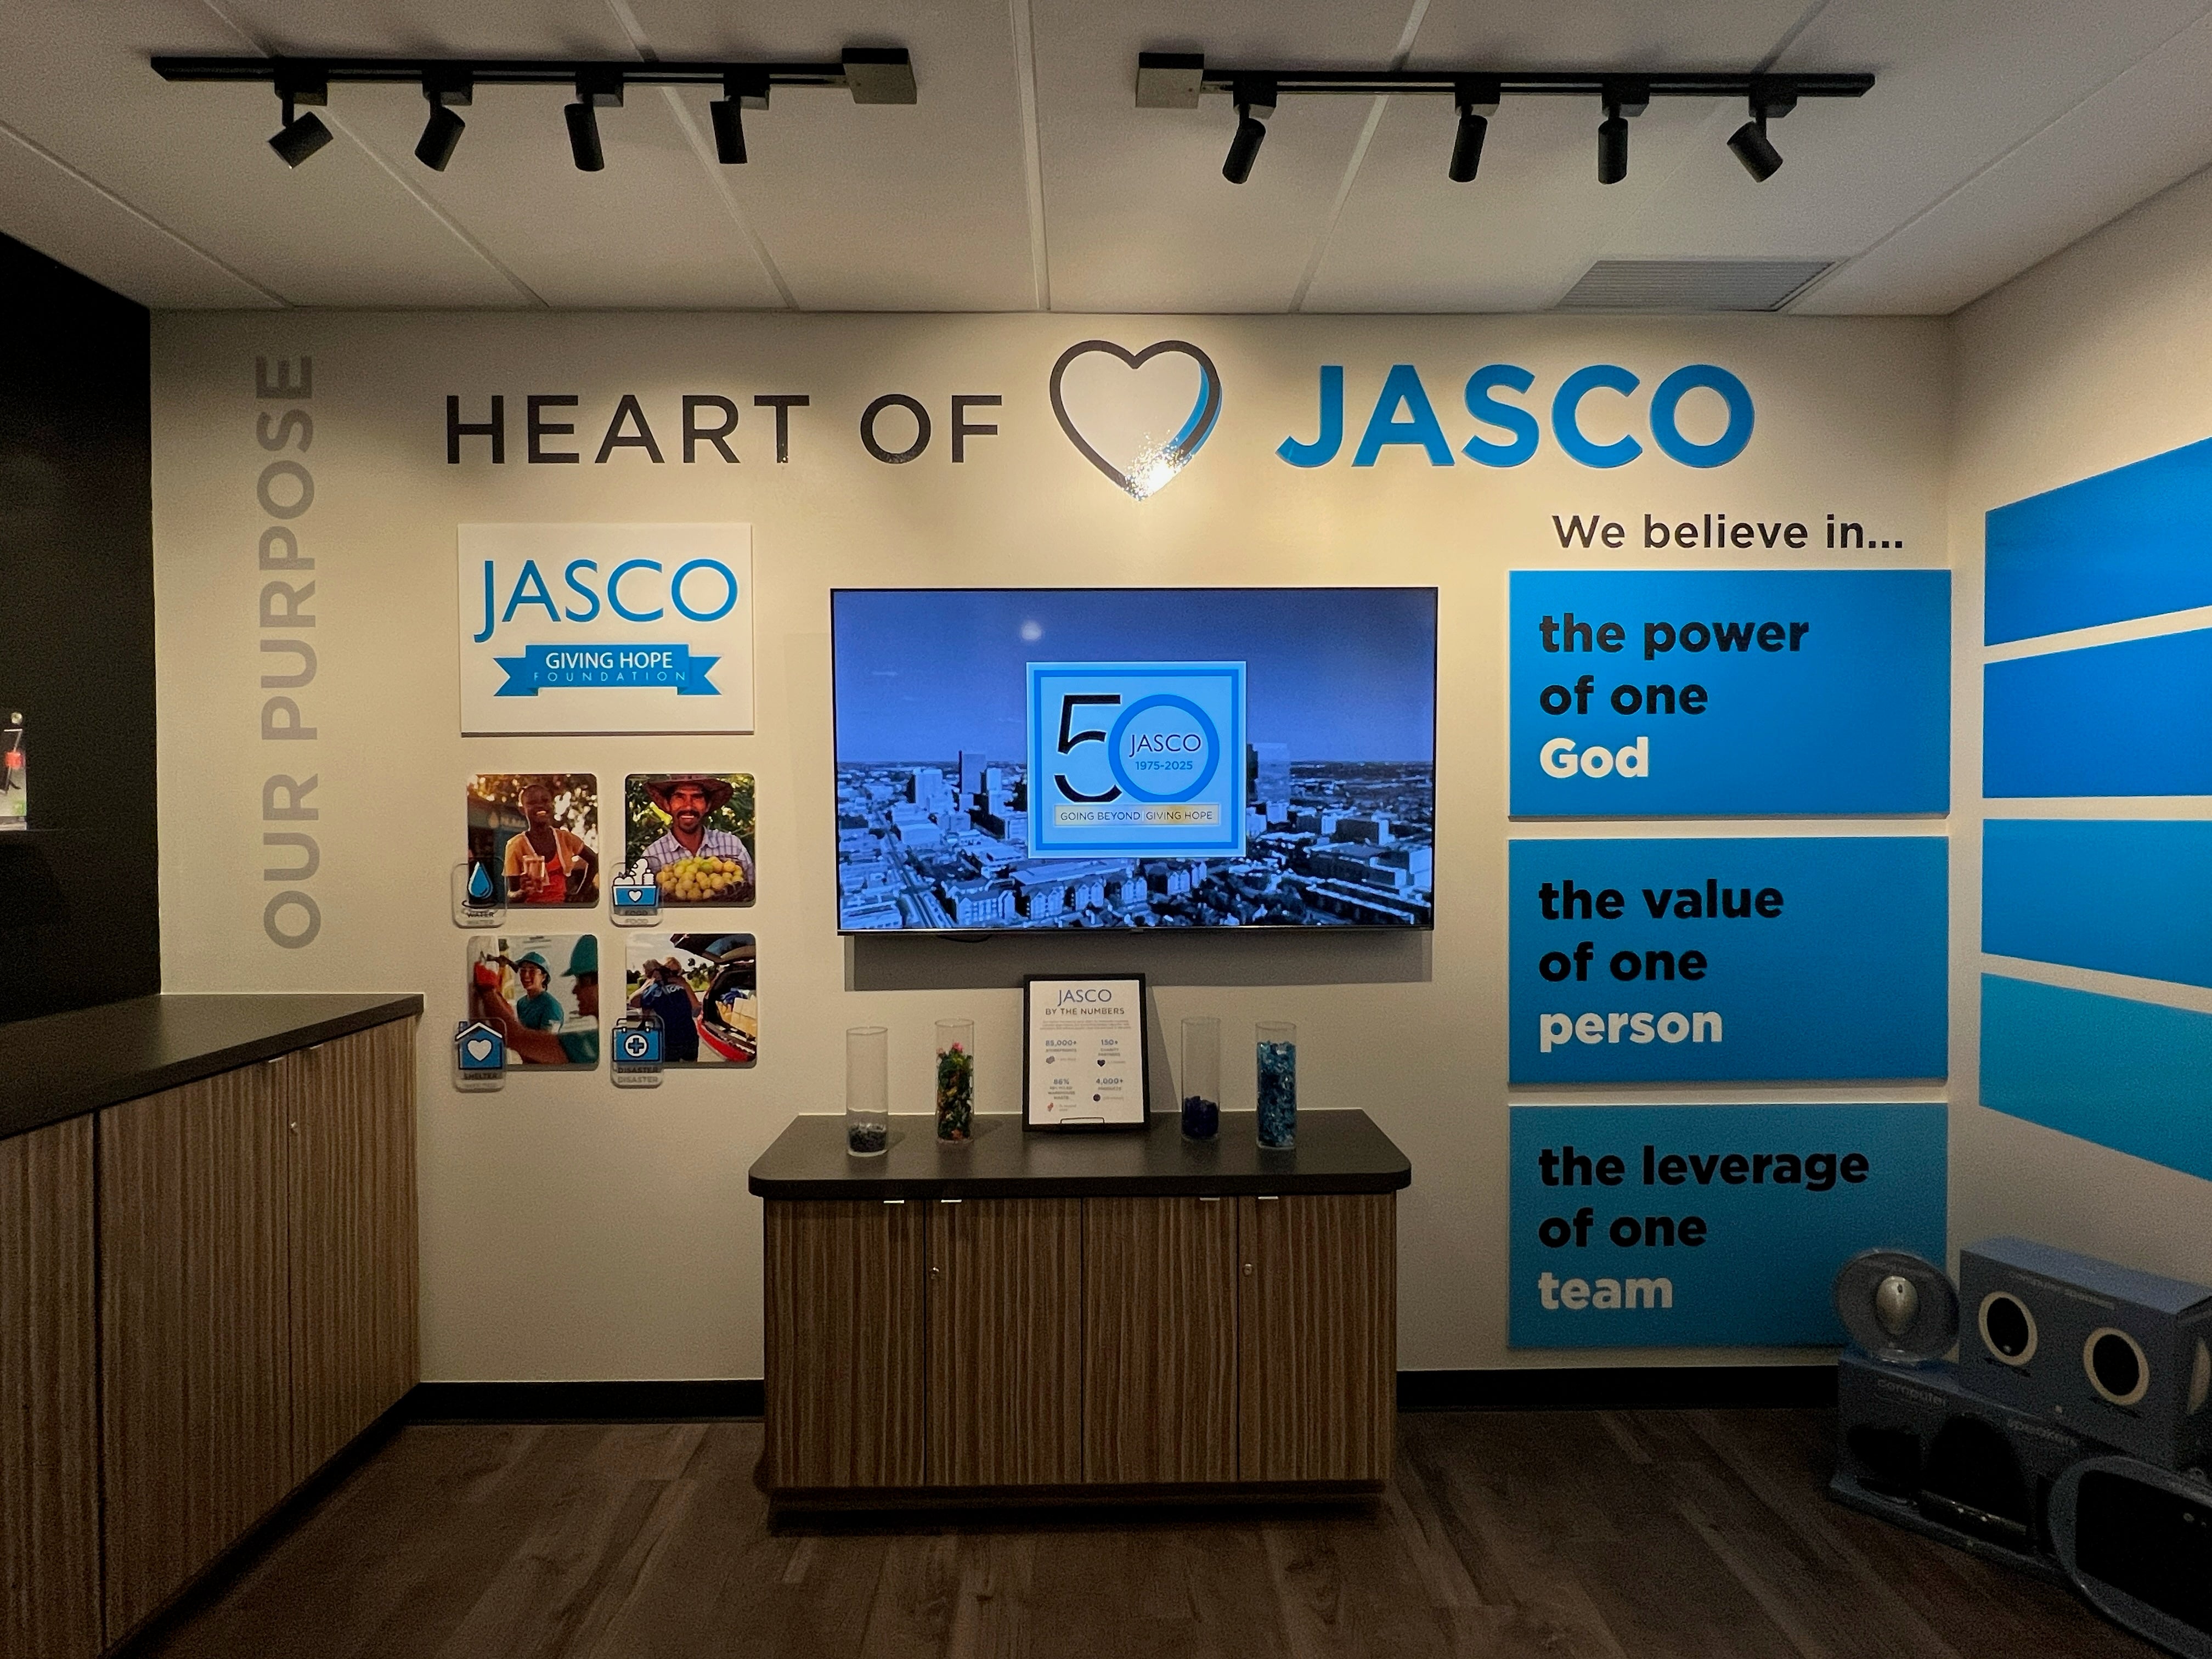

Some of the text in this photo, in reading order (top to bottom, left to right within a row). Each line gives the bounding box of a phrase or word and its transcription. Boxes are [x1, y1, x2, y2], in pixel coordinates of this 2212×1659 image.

[446, 393, 1003, 465] HEART OF
[1275, 363, 1756, 469] JASCO
[1553, 514, 1903, 549] We believe in...
[473, 558, 738, 643] JASCO
[255, 355, 321, 950] OUR PURPOSE
[1539, 613, 1809, 661] the power
[534, 671, 686, 682] FOUNDATION
[545, 651, 673, 670] GIVING HOPE
[1539, 674, 1708, 715] of one
[1053, 693, 1220, 803] 50
[1128, 734, 1201, 758] JASCO
[1135, 760, 1194, 771] 1975-2025
[1539, 736, 1649, 779] God
[1060, 811, 1213, 821] GOING BEYOND GIVING HOPE
[1538, 878, 1784, 920] the value
[1538, 941, 1707, 981] of one
[1057, 989, 1112, 1007] JASCO
[1539, 1010, 1723, 1053] person
[1538, 1144, 1870, 1192] the leverage
[1538, 1207, 1708, 1249] of one
[1538, 1271, 1673, 1310] team
